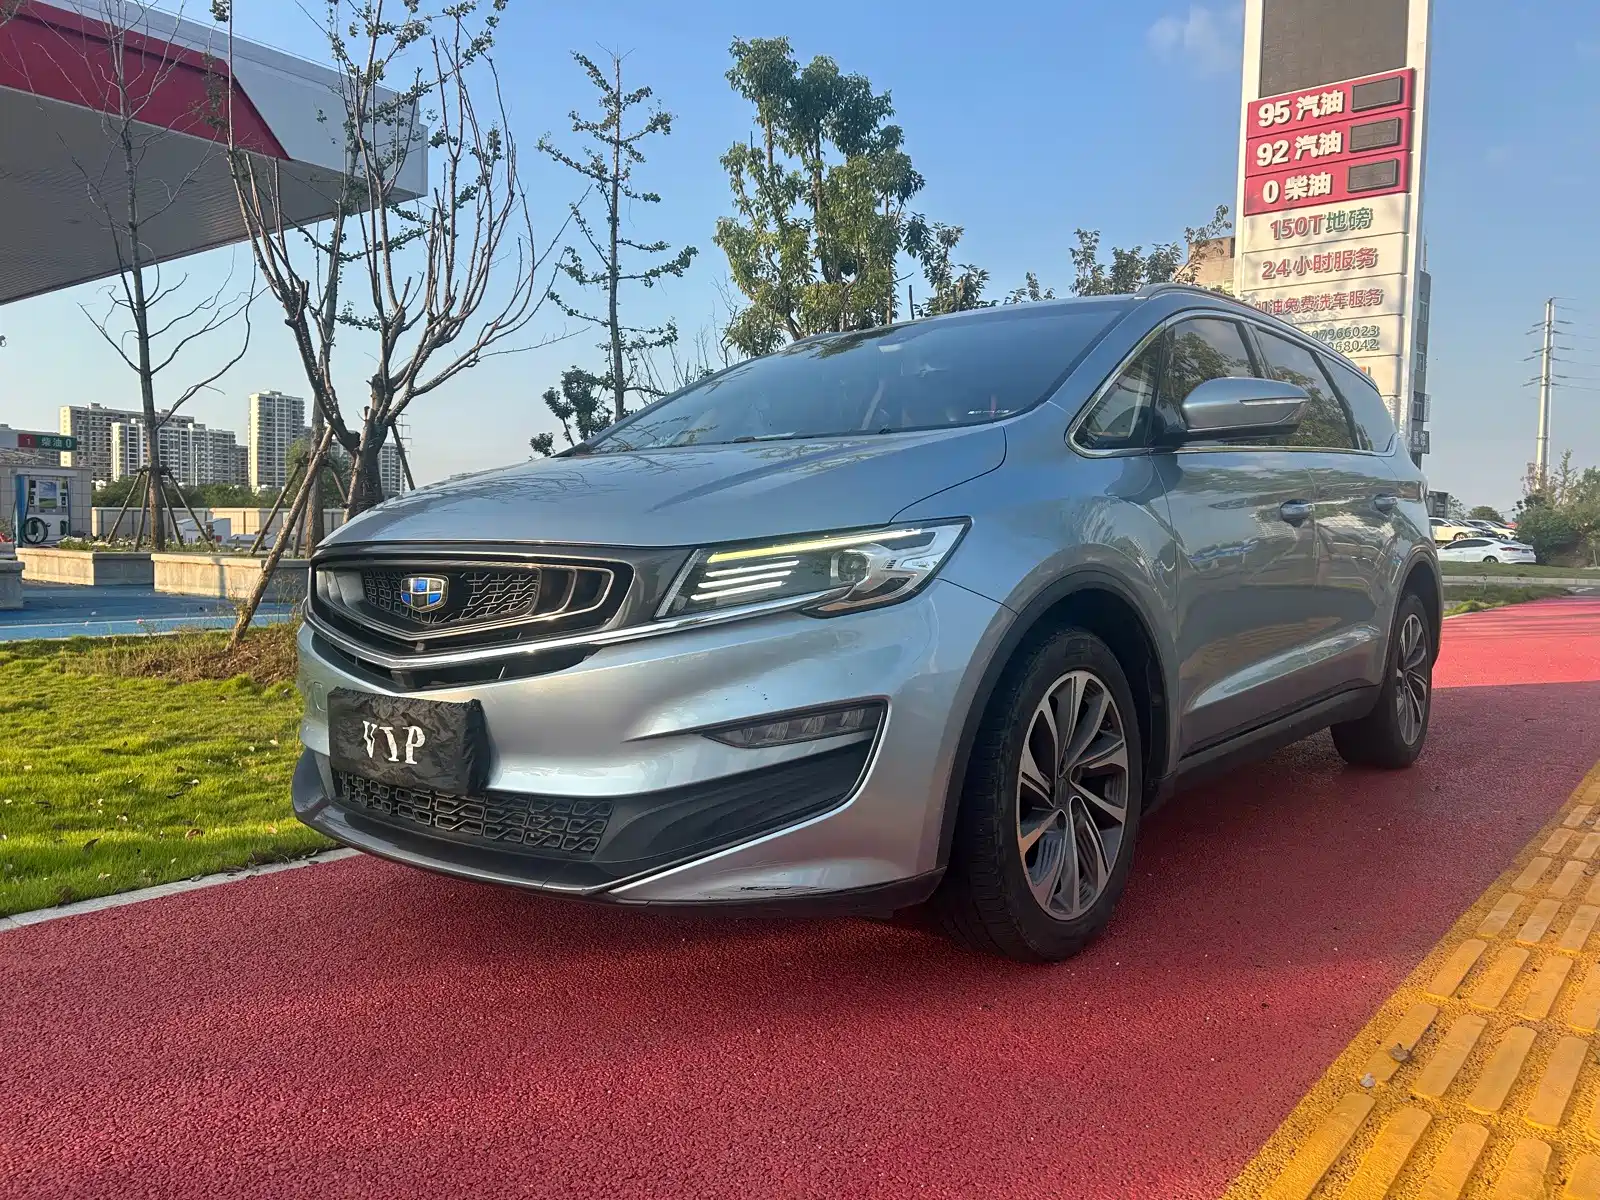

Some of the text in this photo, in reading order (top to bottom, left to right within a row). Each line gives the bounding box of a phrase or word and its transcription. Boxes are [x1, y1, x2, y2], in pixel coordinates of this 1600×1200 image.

[1258, 89, 1344, 128] 95 汽油
[1256, 130, 1342, 167] 92 汽油
[1262, 172, 1332, 204] 0 柴油
[1270, 207, 1373, 240] 150T地磅
[1262, 247, 1377, 279] 24小时服务
[362, 720, 426, 765] VIP
